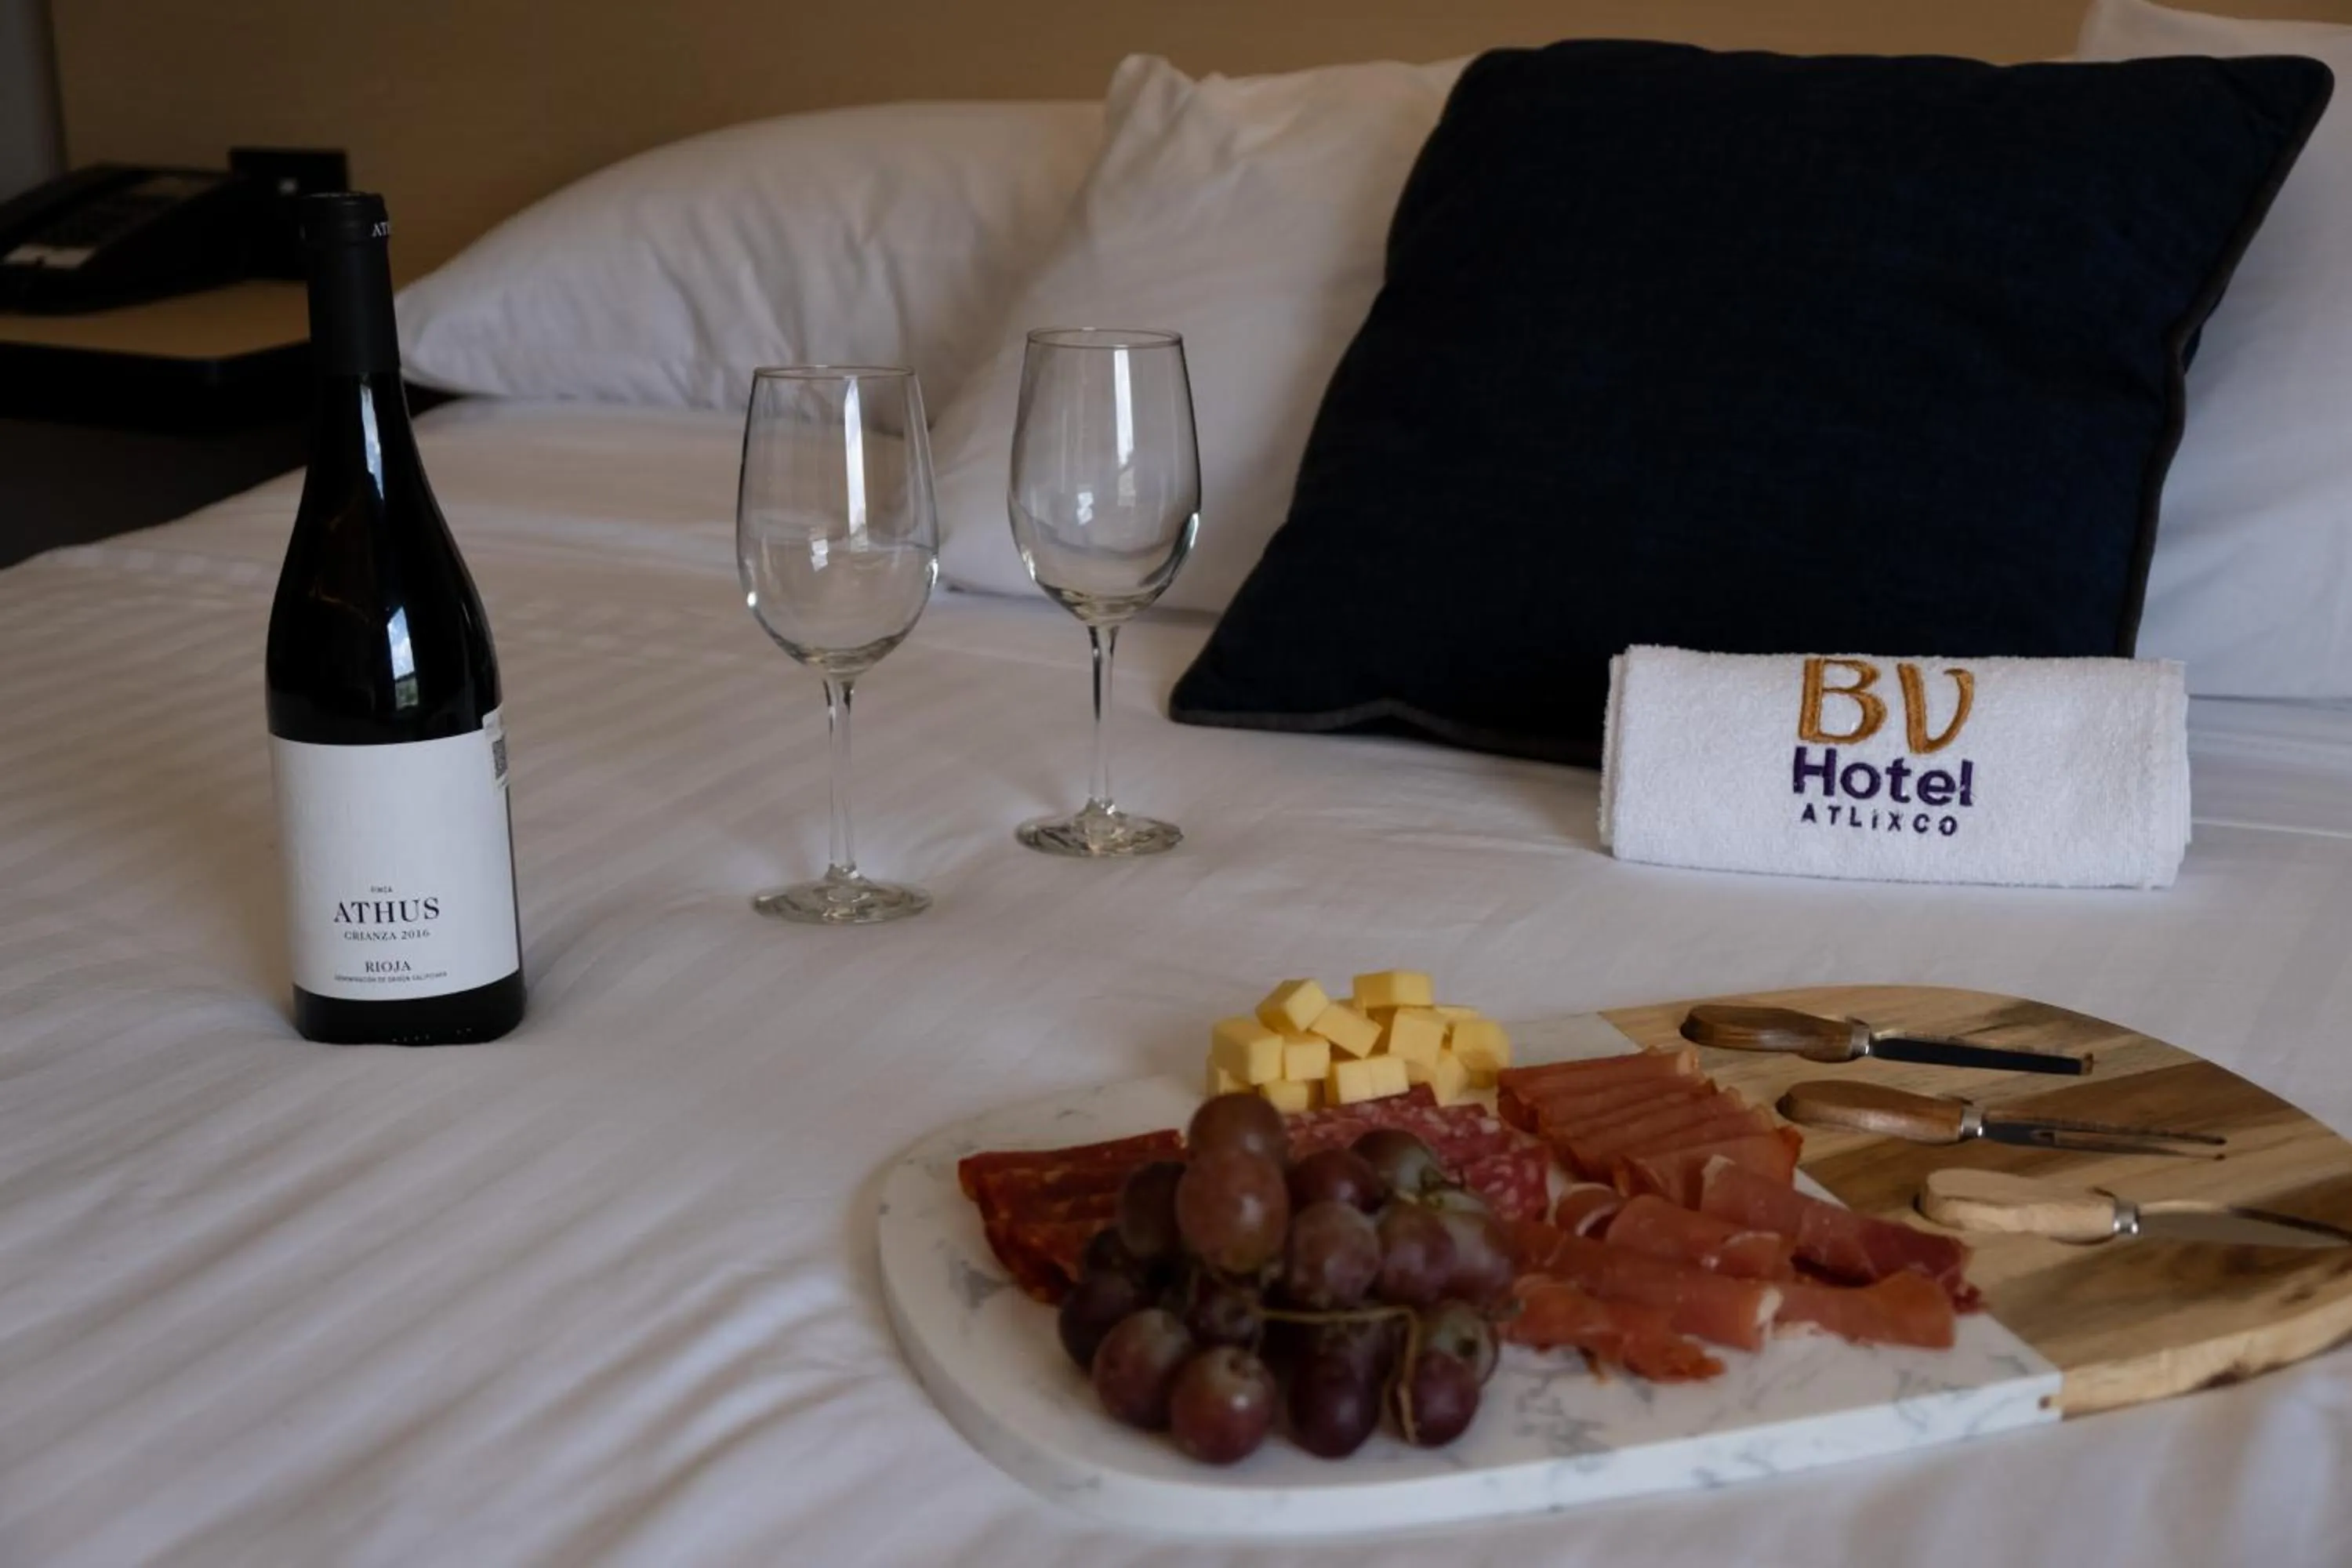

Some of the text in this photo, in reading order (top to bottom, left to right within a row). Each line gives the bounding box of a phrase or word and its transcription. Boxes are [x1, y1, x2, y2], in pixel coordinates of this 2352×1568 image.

[1798, 657, 1974, 754] BV
[1792, 746, 1974, 808] Hotel
[333, 896, 440, 924] ATHUS
[344, 930, 430, 942] CRIANZA 2016
[365, 960, 412, 973] RIOJA
